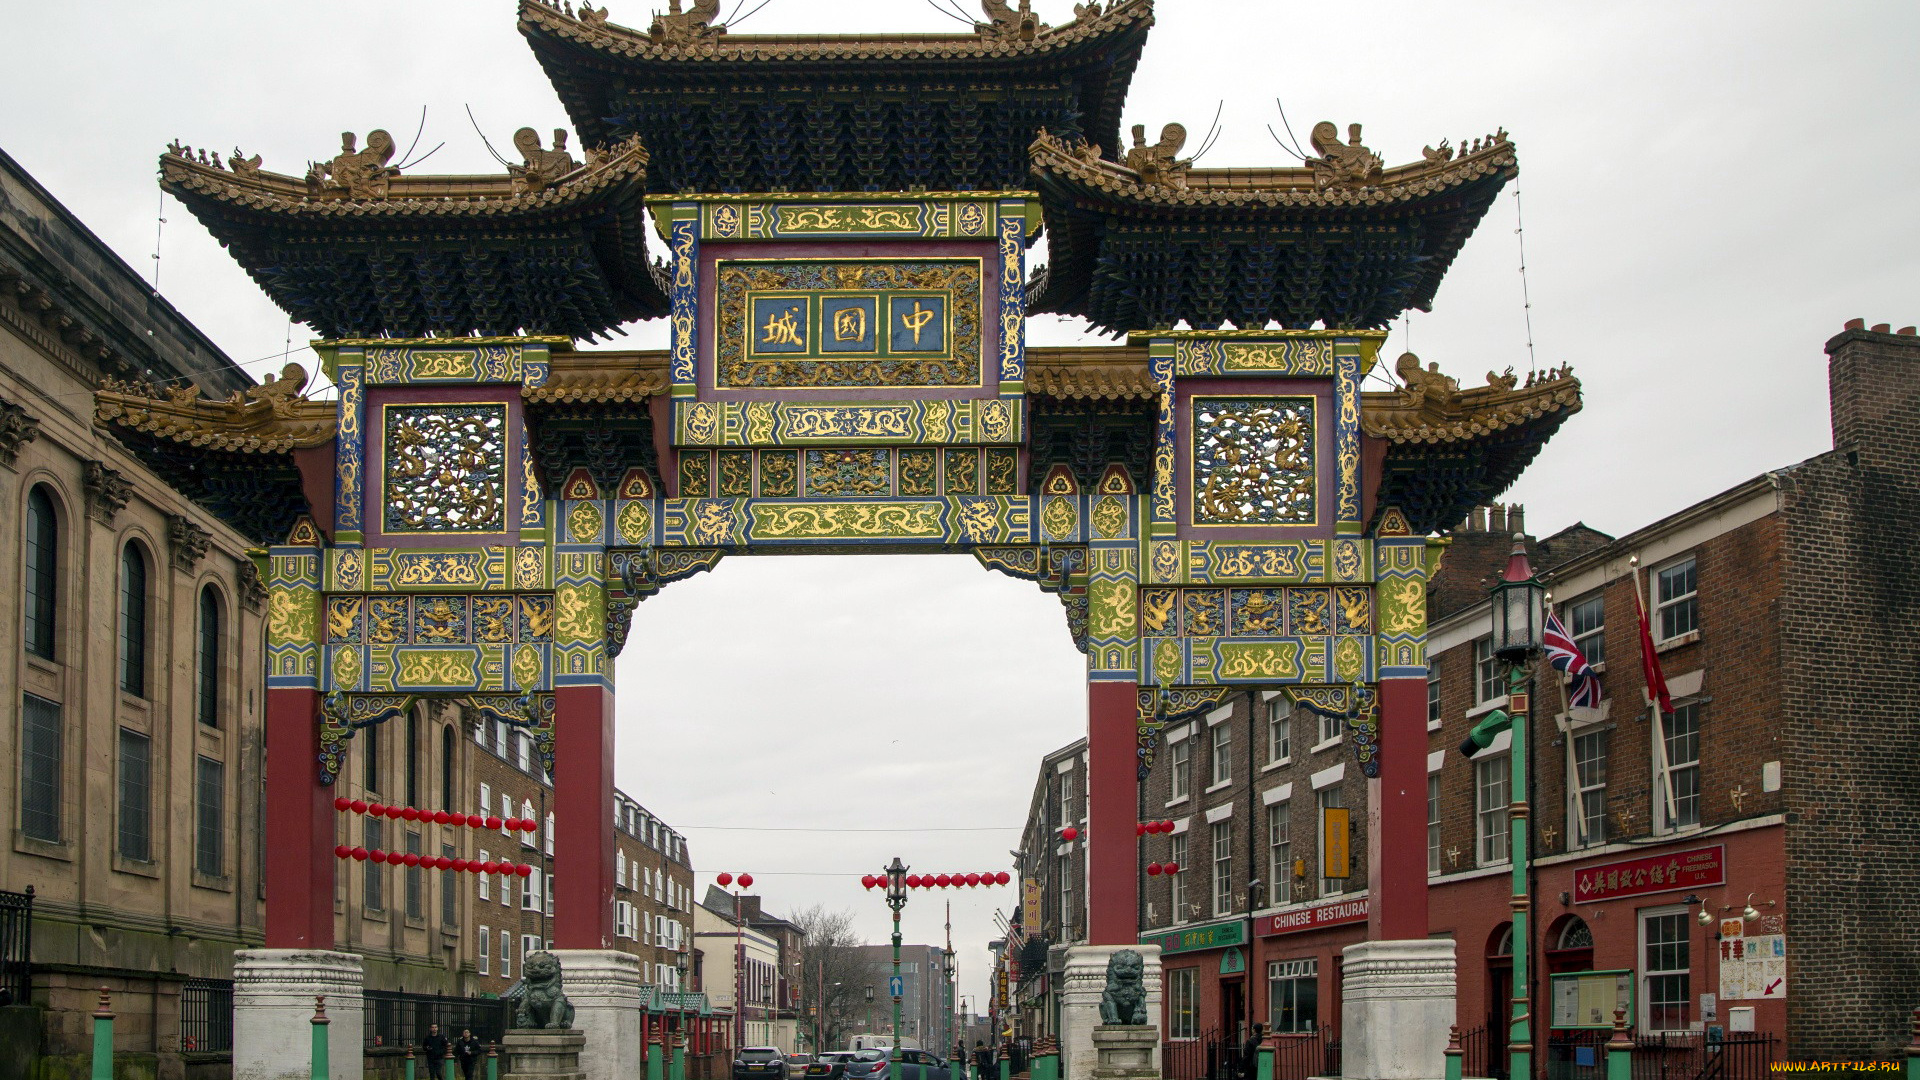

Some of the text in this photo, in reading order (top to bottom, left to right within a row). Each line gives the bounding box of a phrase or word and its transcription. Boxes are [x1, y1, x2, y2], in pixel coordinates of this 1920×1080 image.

[1686, 852, 1713, 864] CHINESE
[1681, 861, 1719, 873] FREEMASON
[1274, 911, 1311, 929] CHINESE
